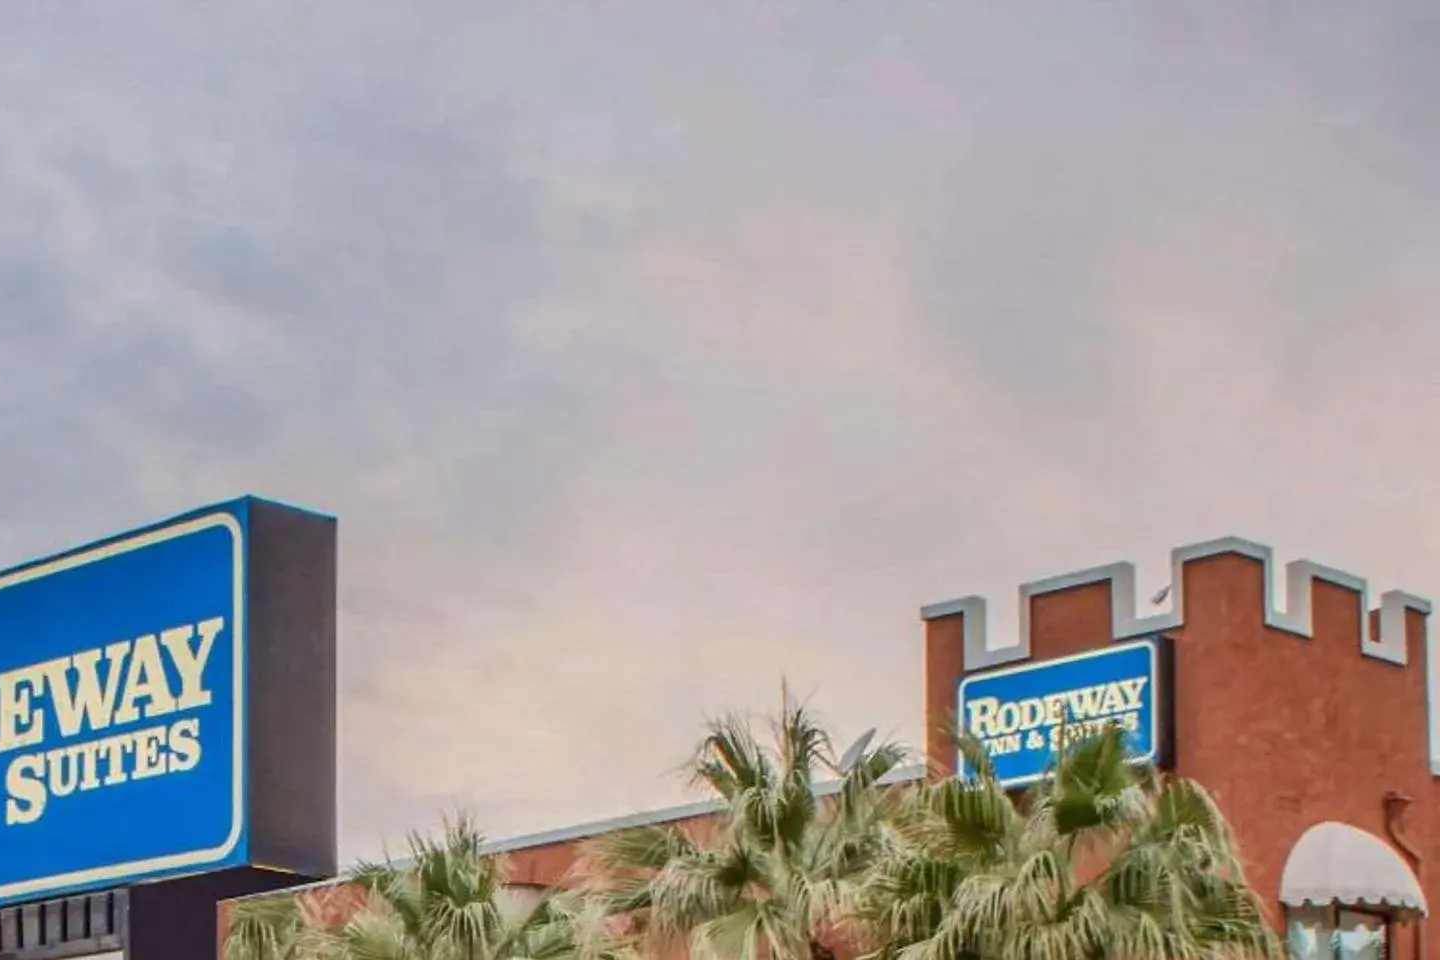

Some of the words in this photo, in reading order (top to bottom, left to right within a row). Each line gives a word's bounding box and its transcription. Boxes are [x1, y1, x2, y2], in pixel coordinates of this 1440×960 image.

[966, 676, 1148, 738] RODEWAY
[5, 718, 201, 825] SUITES
[980, 733, 1021, 760] NN
[1025, 729, 1045, 750] &
